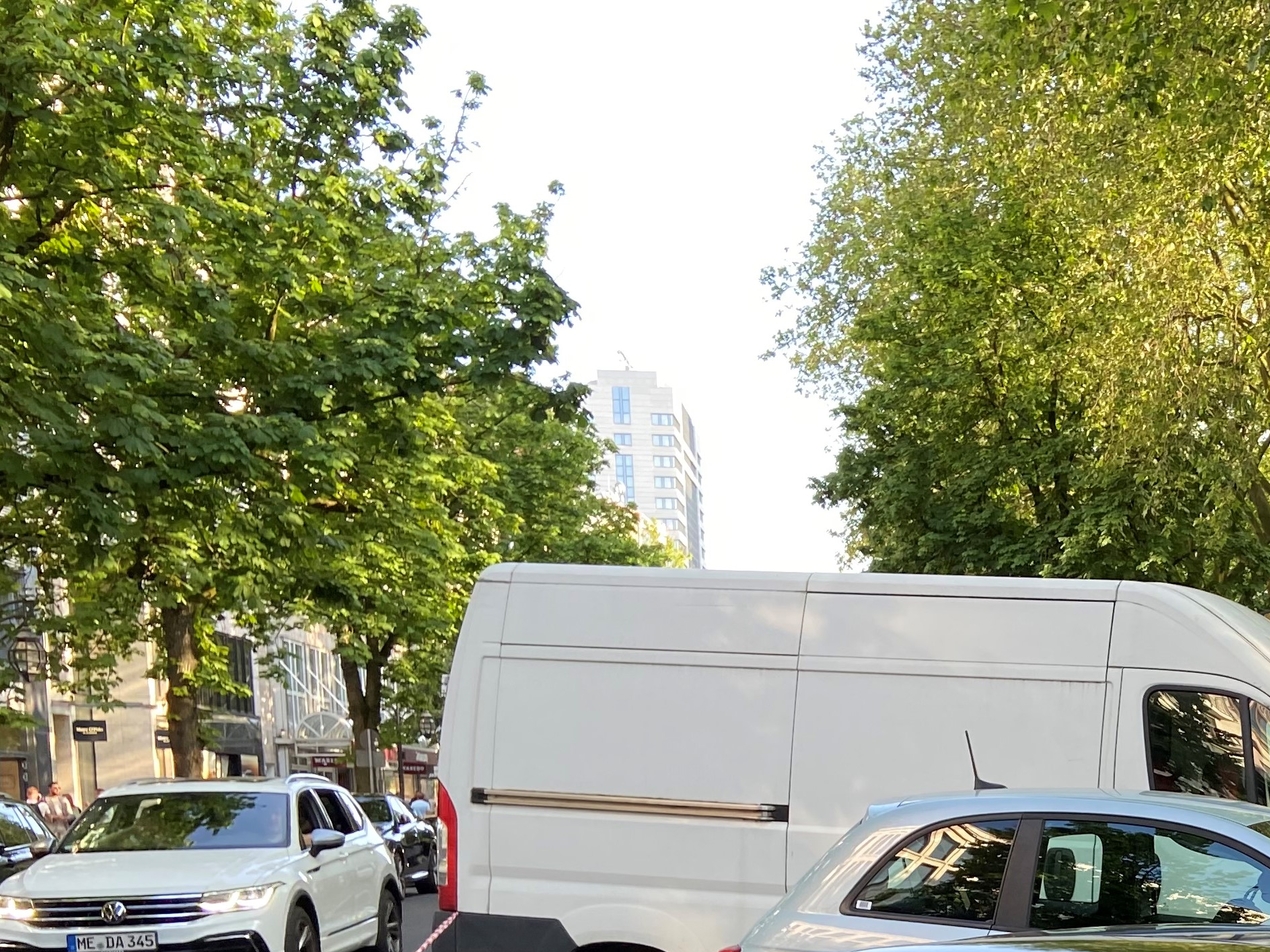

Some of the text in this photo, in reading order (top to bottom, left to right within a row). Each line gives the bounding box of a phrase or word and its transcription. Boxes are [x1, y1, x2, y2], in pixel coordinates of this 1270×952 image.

[77, 935, 154, 950] ME DA 345
